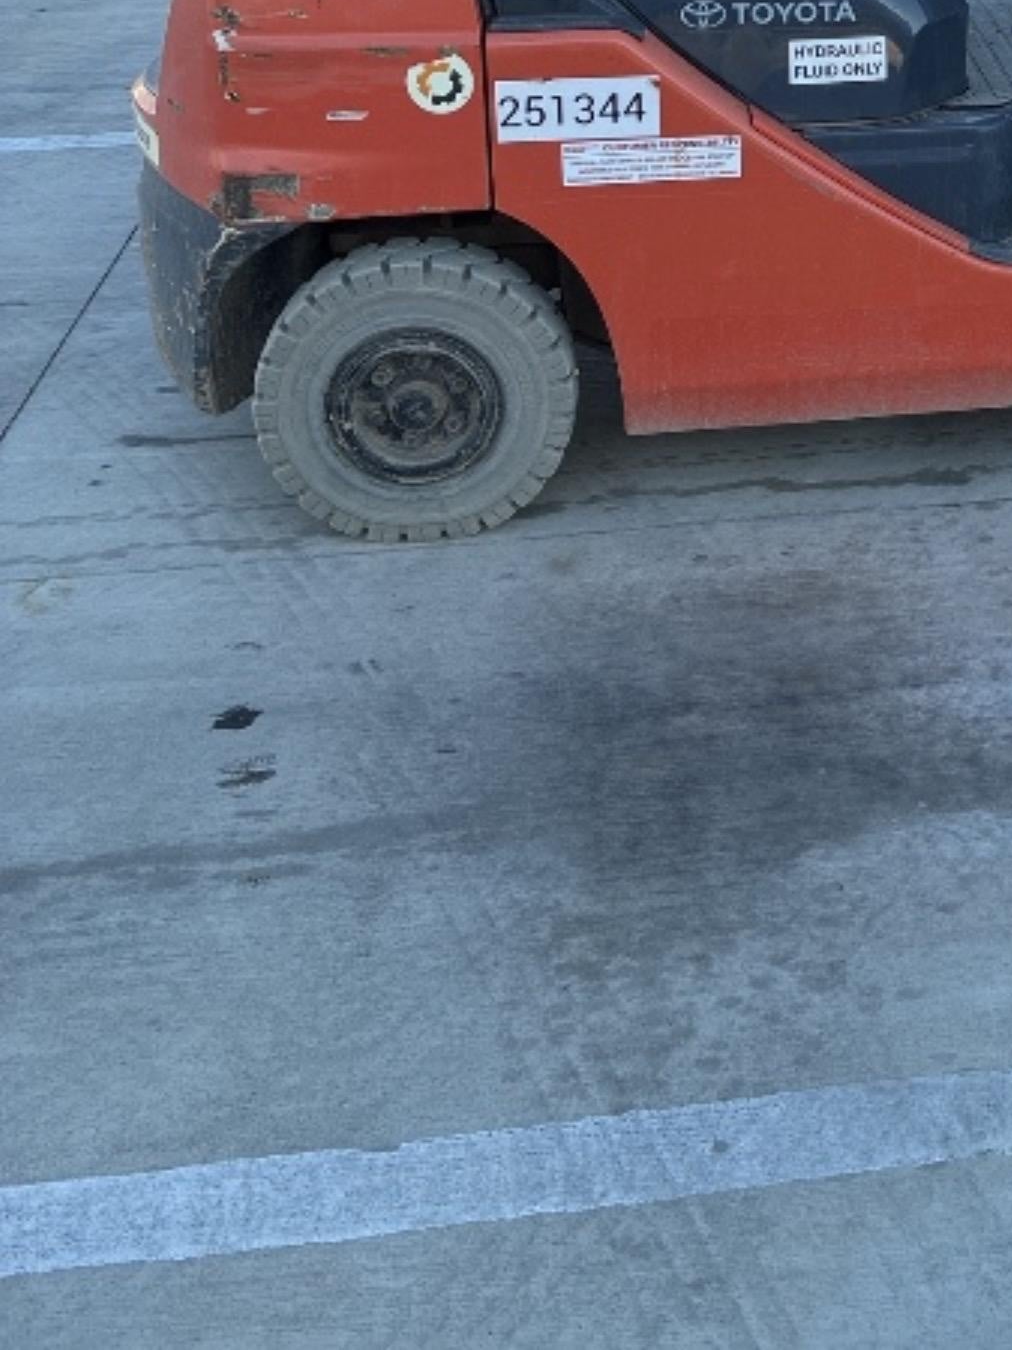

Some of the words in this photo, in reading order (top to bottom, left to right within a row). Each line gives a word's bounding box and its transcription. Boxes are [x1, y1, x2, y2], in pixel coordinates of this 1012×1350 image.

[731, 0, 857, 26] TOYOTA
[794, 41, 883, 59] HYDRAULIC
[794, 63, 839, 79] FLUID
[842, 61, 883, 77] ONLY
[498, 91, 647, 128] 251344
